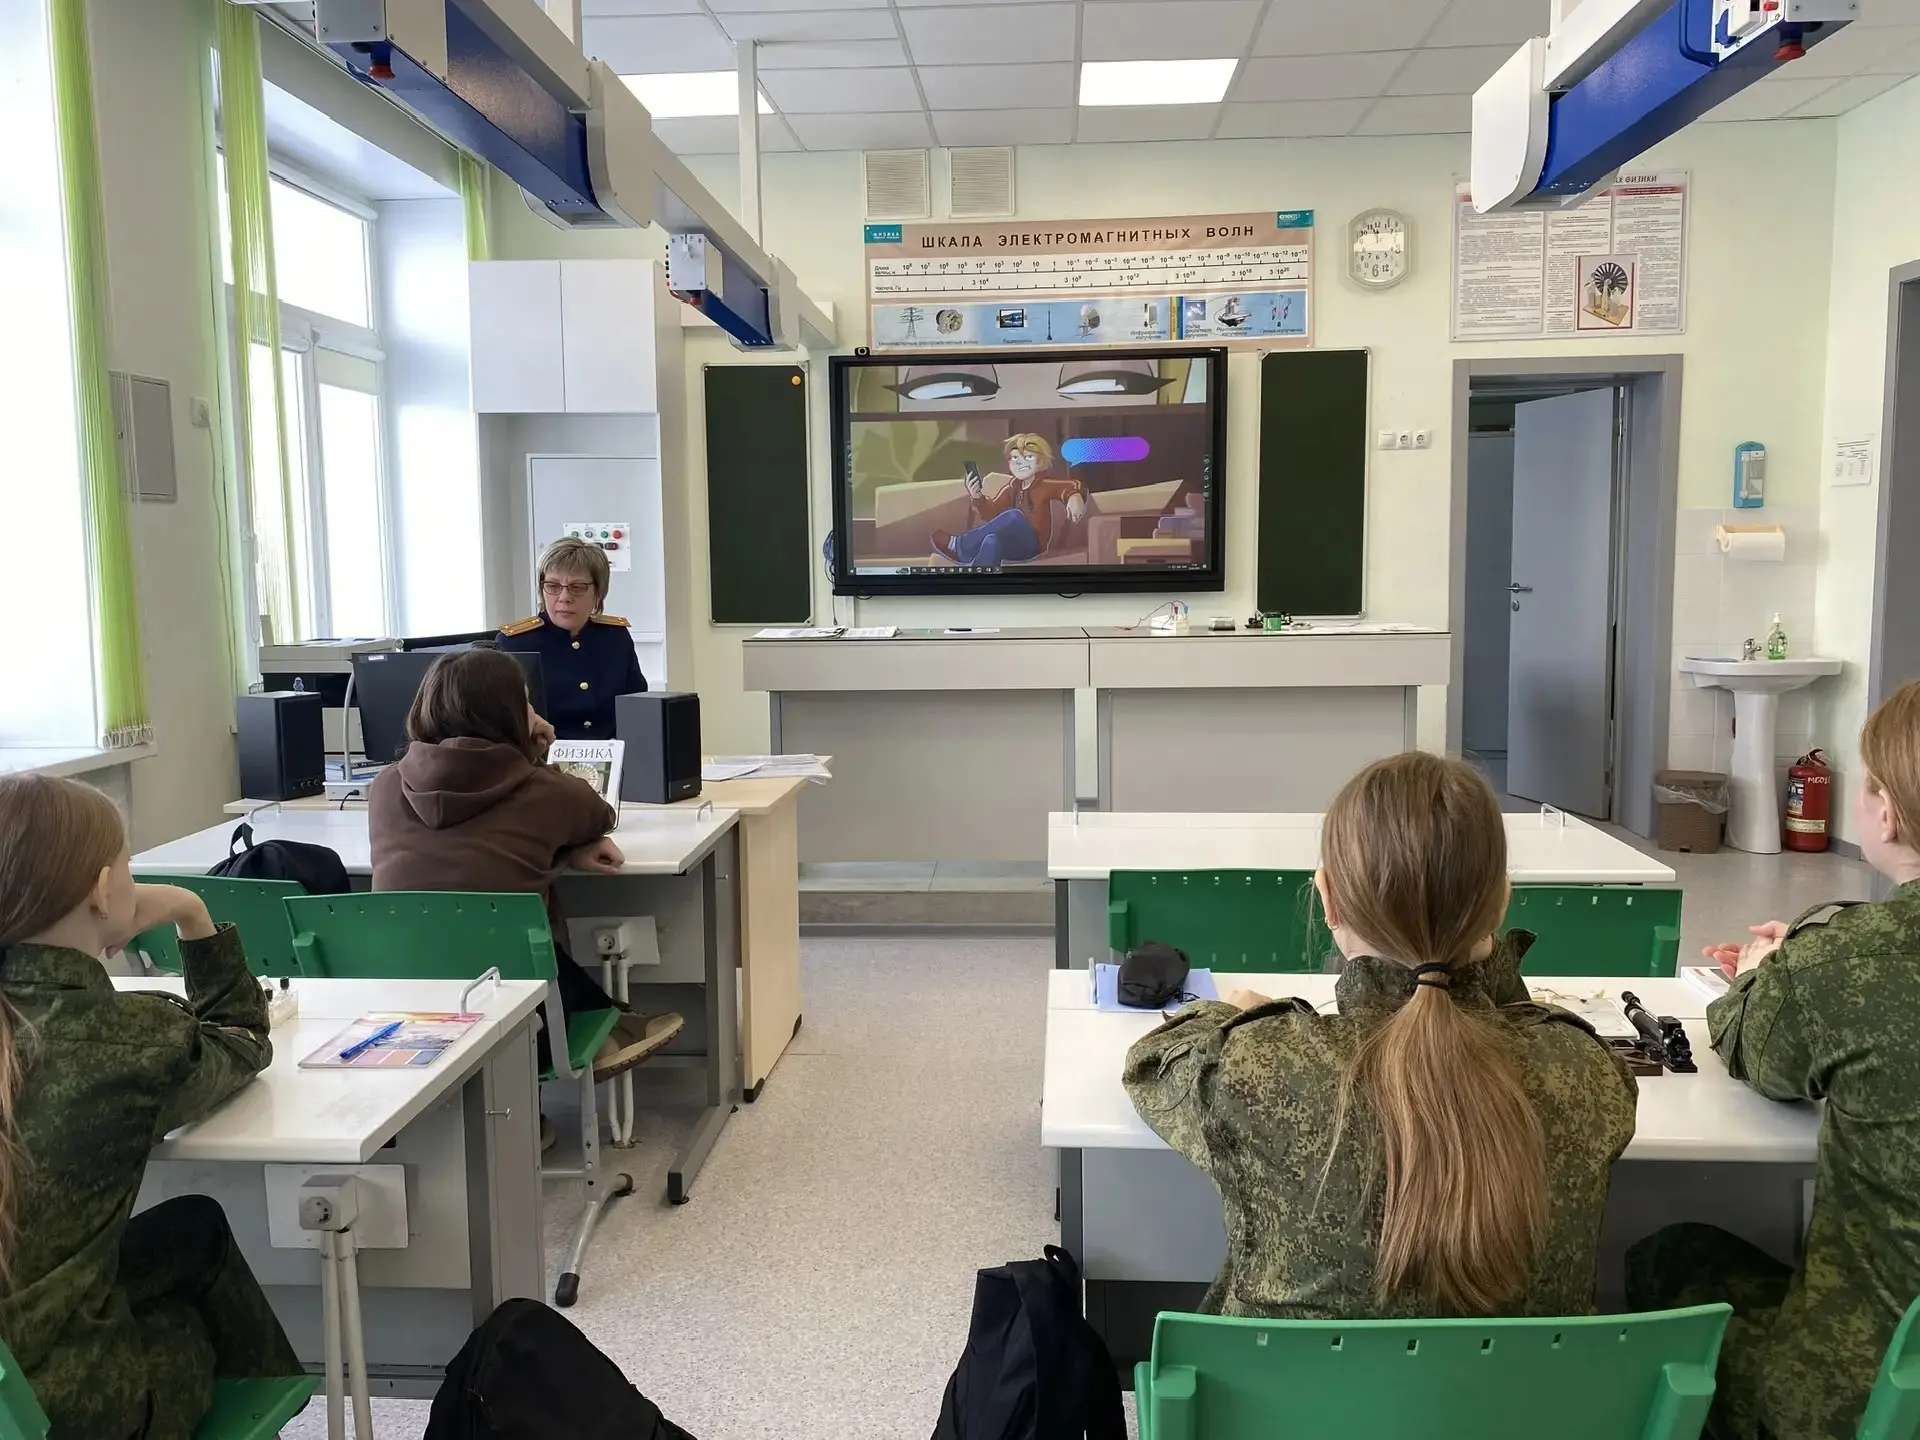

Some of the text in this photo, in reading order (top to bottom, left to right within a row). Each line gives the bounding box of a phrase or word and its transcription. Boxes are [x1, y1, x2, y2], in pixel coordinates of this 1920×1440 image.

[921, 225, 1254, 248] ШКАЛА ЭЛЕКТРОМАГНИТНЫХ ВОЛН
[553, 748, 613, 759] ФИЗИКА
